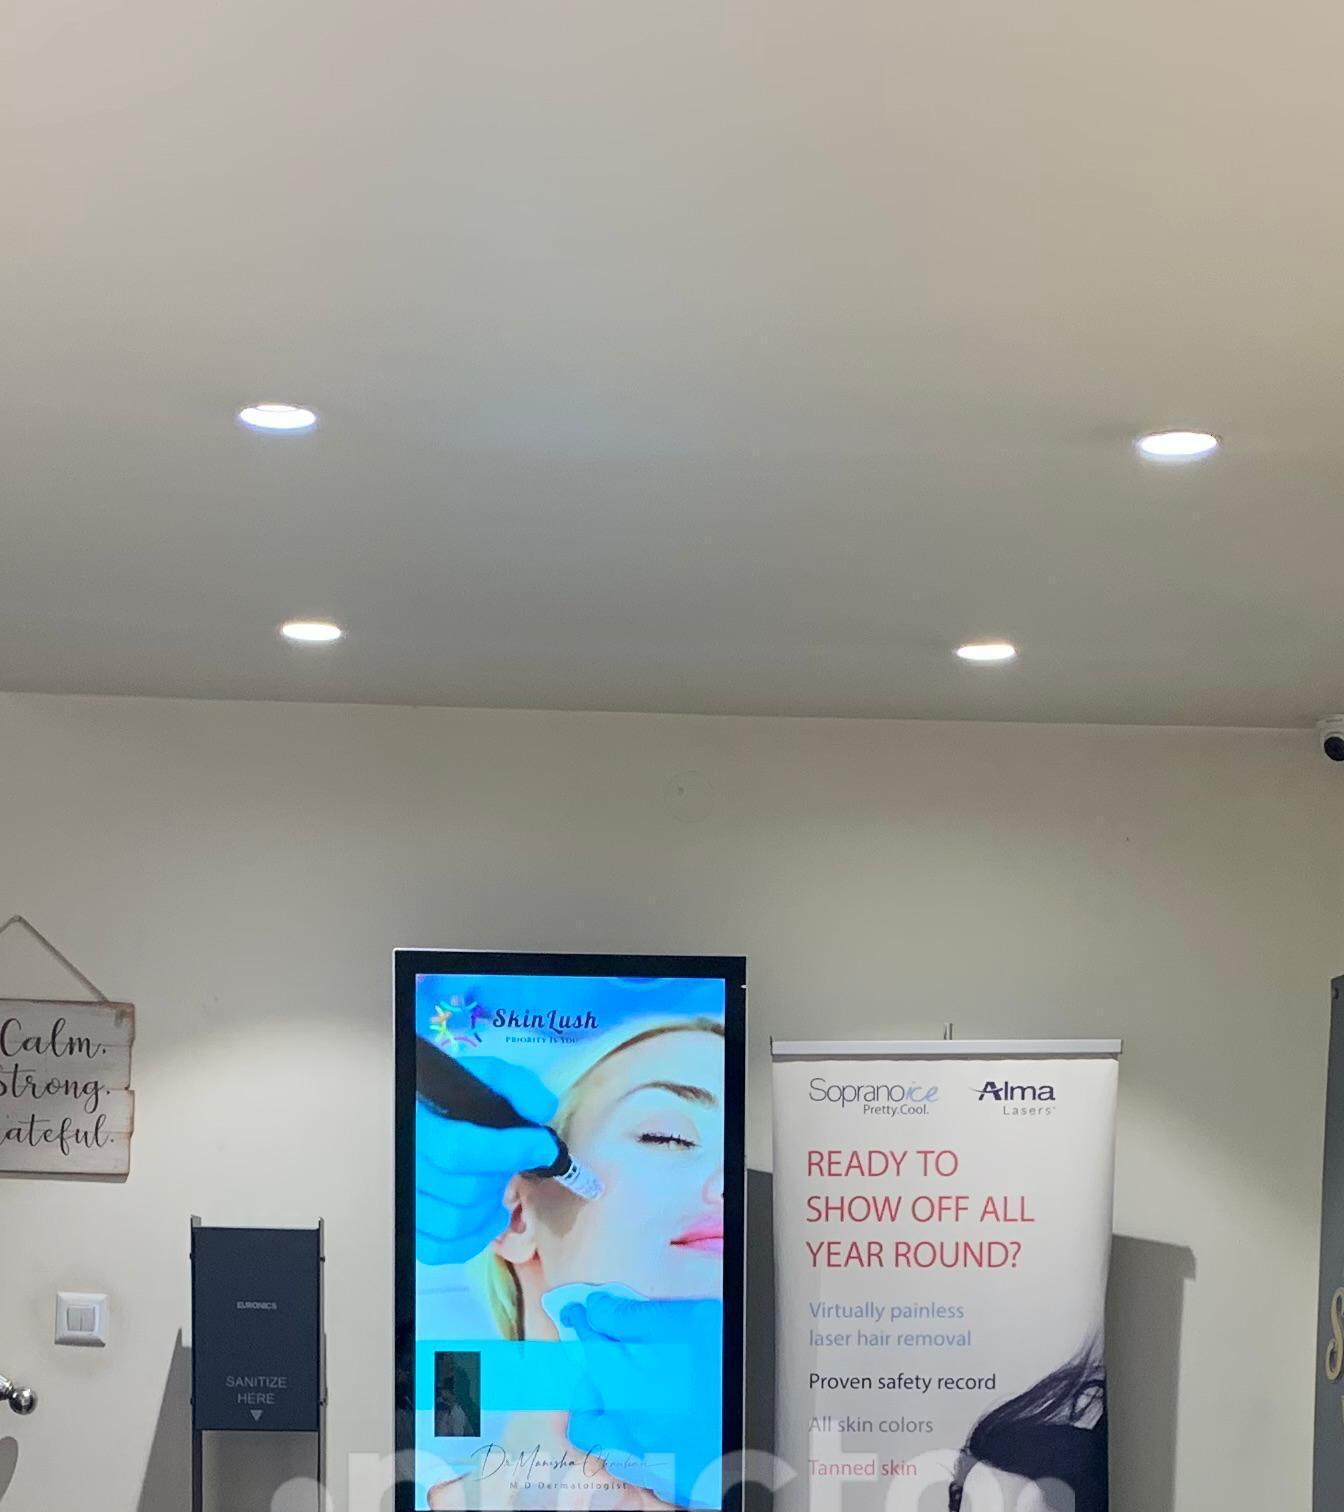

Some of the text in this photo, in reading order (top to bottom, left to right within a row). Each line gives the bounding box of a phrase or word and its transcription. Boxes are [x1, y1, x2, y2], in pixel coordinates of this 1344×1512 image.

[970, 1080, 1057, 1101] Alma
[1003, 1105, 1053, 1116] Lasers
[807, 1150, 959, 1177] READY TO
[806, 1195, 1035, 1223] SHOW OFF ALL
[805, 1241, 1022, 1269] YEAR ROUND?
[809, 1302, 965, 1322] Virtually painless
[809, 1330, 971, 1346] laser hair removal
[225, 1375, 288, 1389] SANITIZE
[809, 1372, 996, 1393] Proven safety record
[237, 1392, 276, 1405] HERE
[808, 1416, 934, 1433] All skin colors
[808, 1459, 917, 1476] Tanned skin
[537, 1482, 628, 1492] Dermatologist
